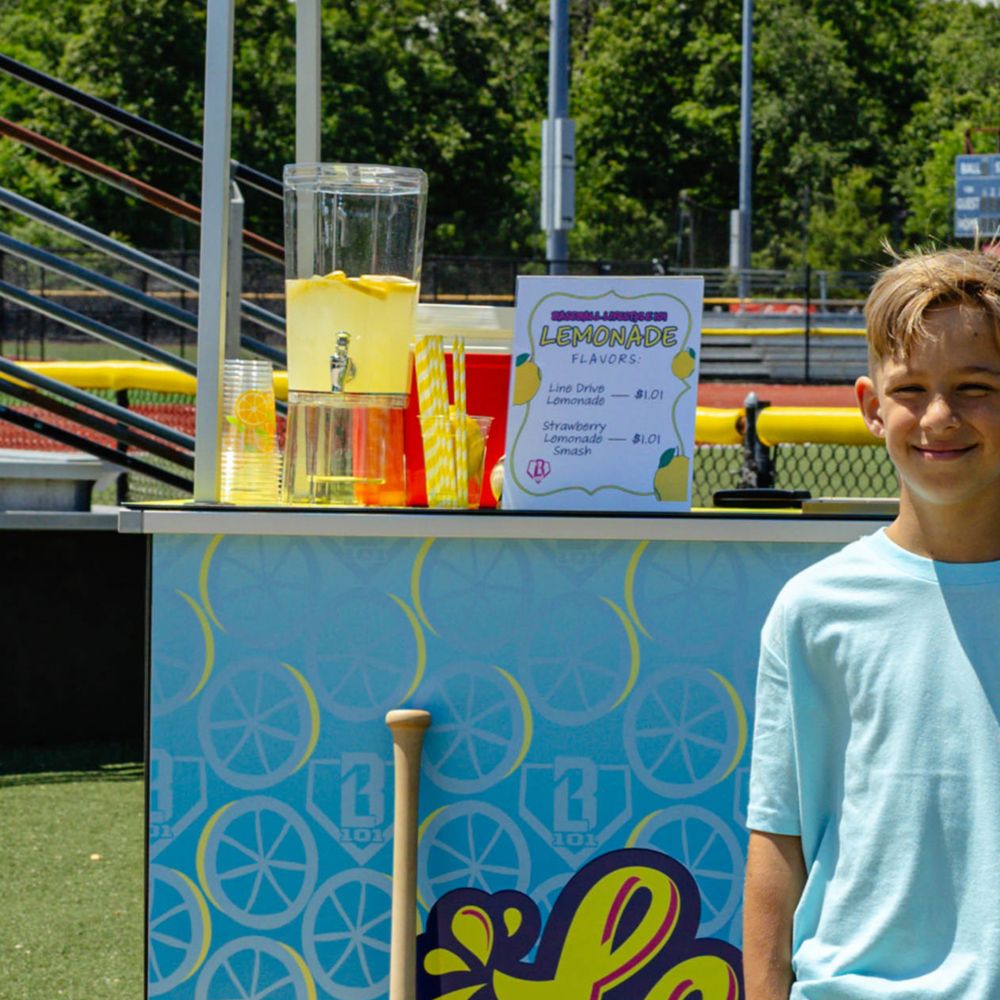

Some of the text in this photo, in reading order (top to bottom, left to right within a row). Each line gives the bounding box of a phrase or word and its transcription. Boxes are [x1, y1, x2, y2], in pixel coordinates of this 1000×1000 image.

[539, 324, 678, 349] LEMONADE
[571, 353, 642, 365] FLAVORS:
[549, 383, 605, 393] Line Drive
[634, 388, 663, 400] $1.01
[546, 395, 605, 406] Lemonade
[542, 420, 607, 434] Strawberry
[543, 433, 603, 444] Lemonade
[632, 433, 661, 445] $1.01
[553, 445, 592, 456] Smash
